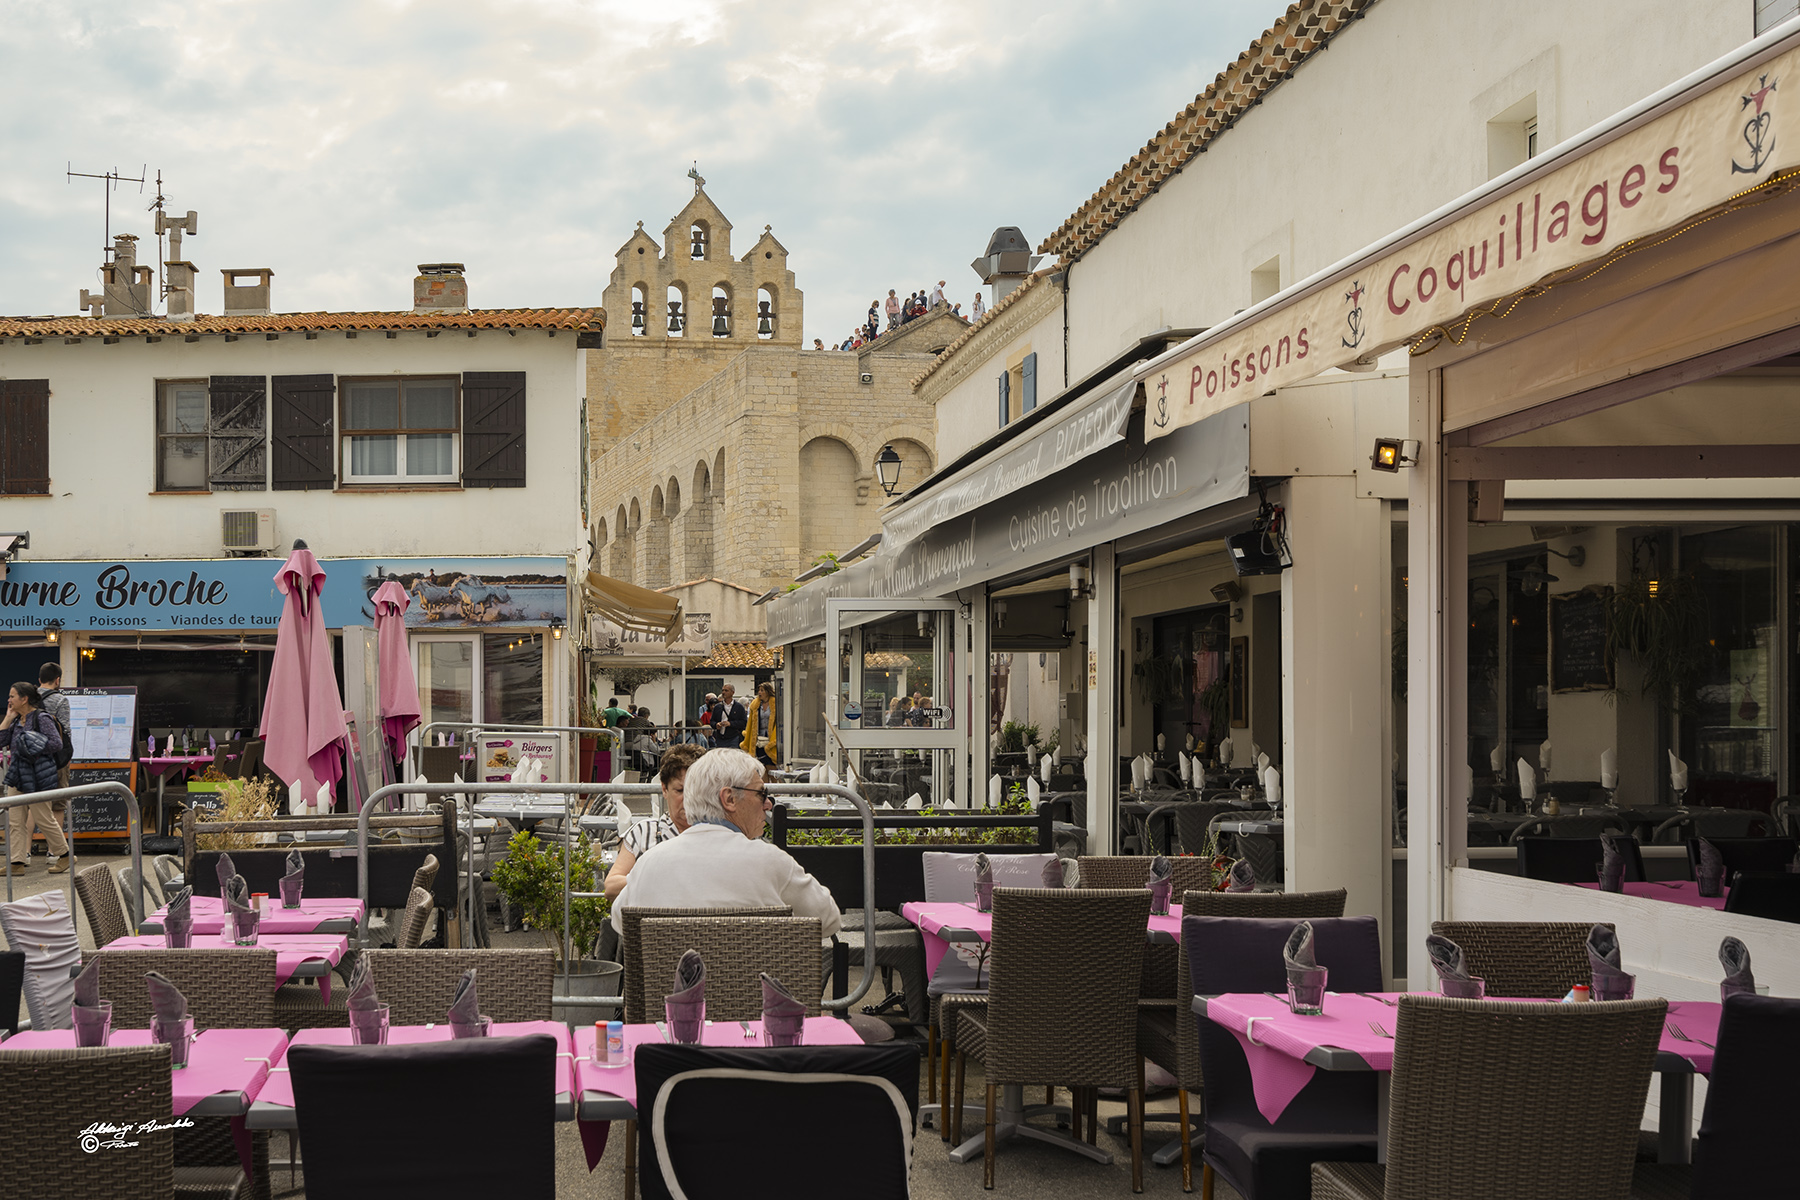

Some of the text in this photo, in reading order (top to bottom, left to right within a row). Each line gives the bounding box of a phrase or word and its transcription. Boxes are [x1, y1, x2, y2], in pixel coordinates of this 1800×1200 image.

[1188, 145, 1682, 405] Poissons Coquillages
[1053, 396, 1120, 467] PIZZERIA
[1008, 455, 1178, 552] Cuisine de Tradition
[918, 516, 977, 585] Provençal
[0, 564, 228, 610] urne Broche
[0, 615, 66, 628] oquillags
[89, 614, 147, 626] Poissons
[171, 613, 224, 625] Viandes
[229, 613, 245, 625] de
[83, 687, 108, 696] Broche
[521, 742, 553, 753] Burgers
[192, 800, 217, 810] Plla
[1005, 865, 1030, 875] Rose
